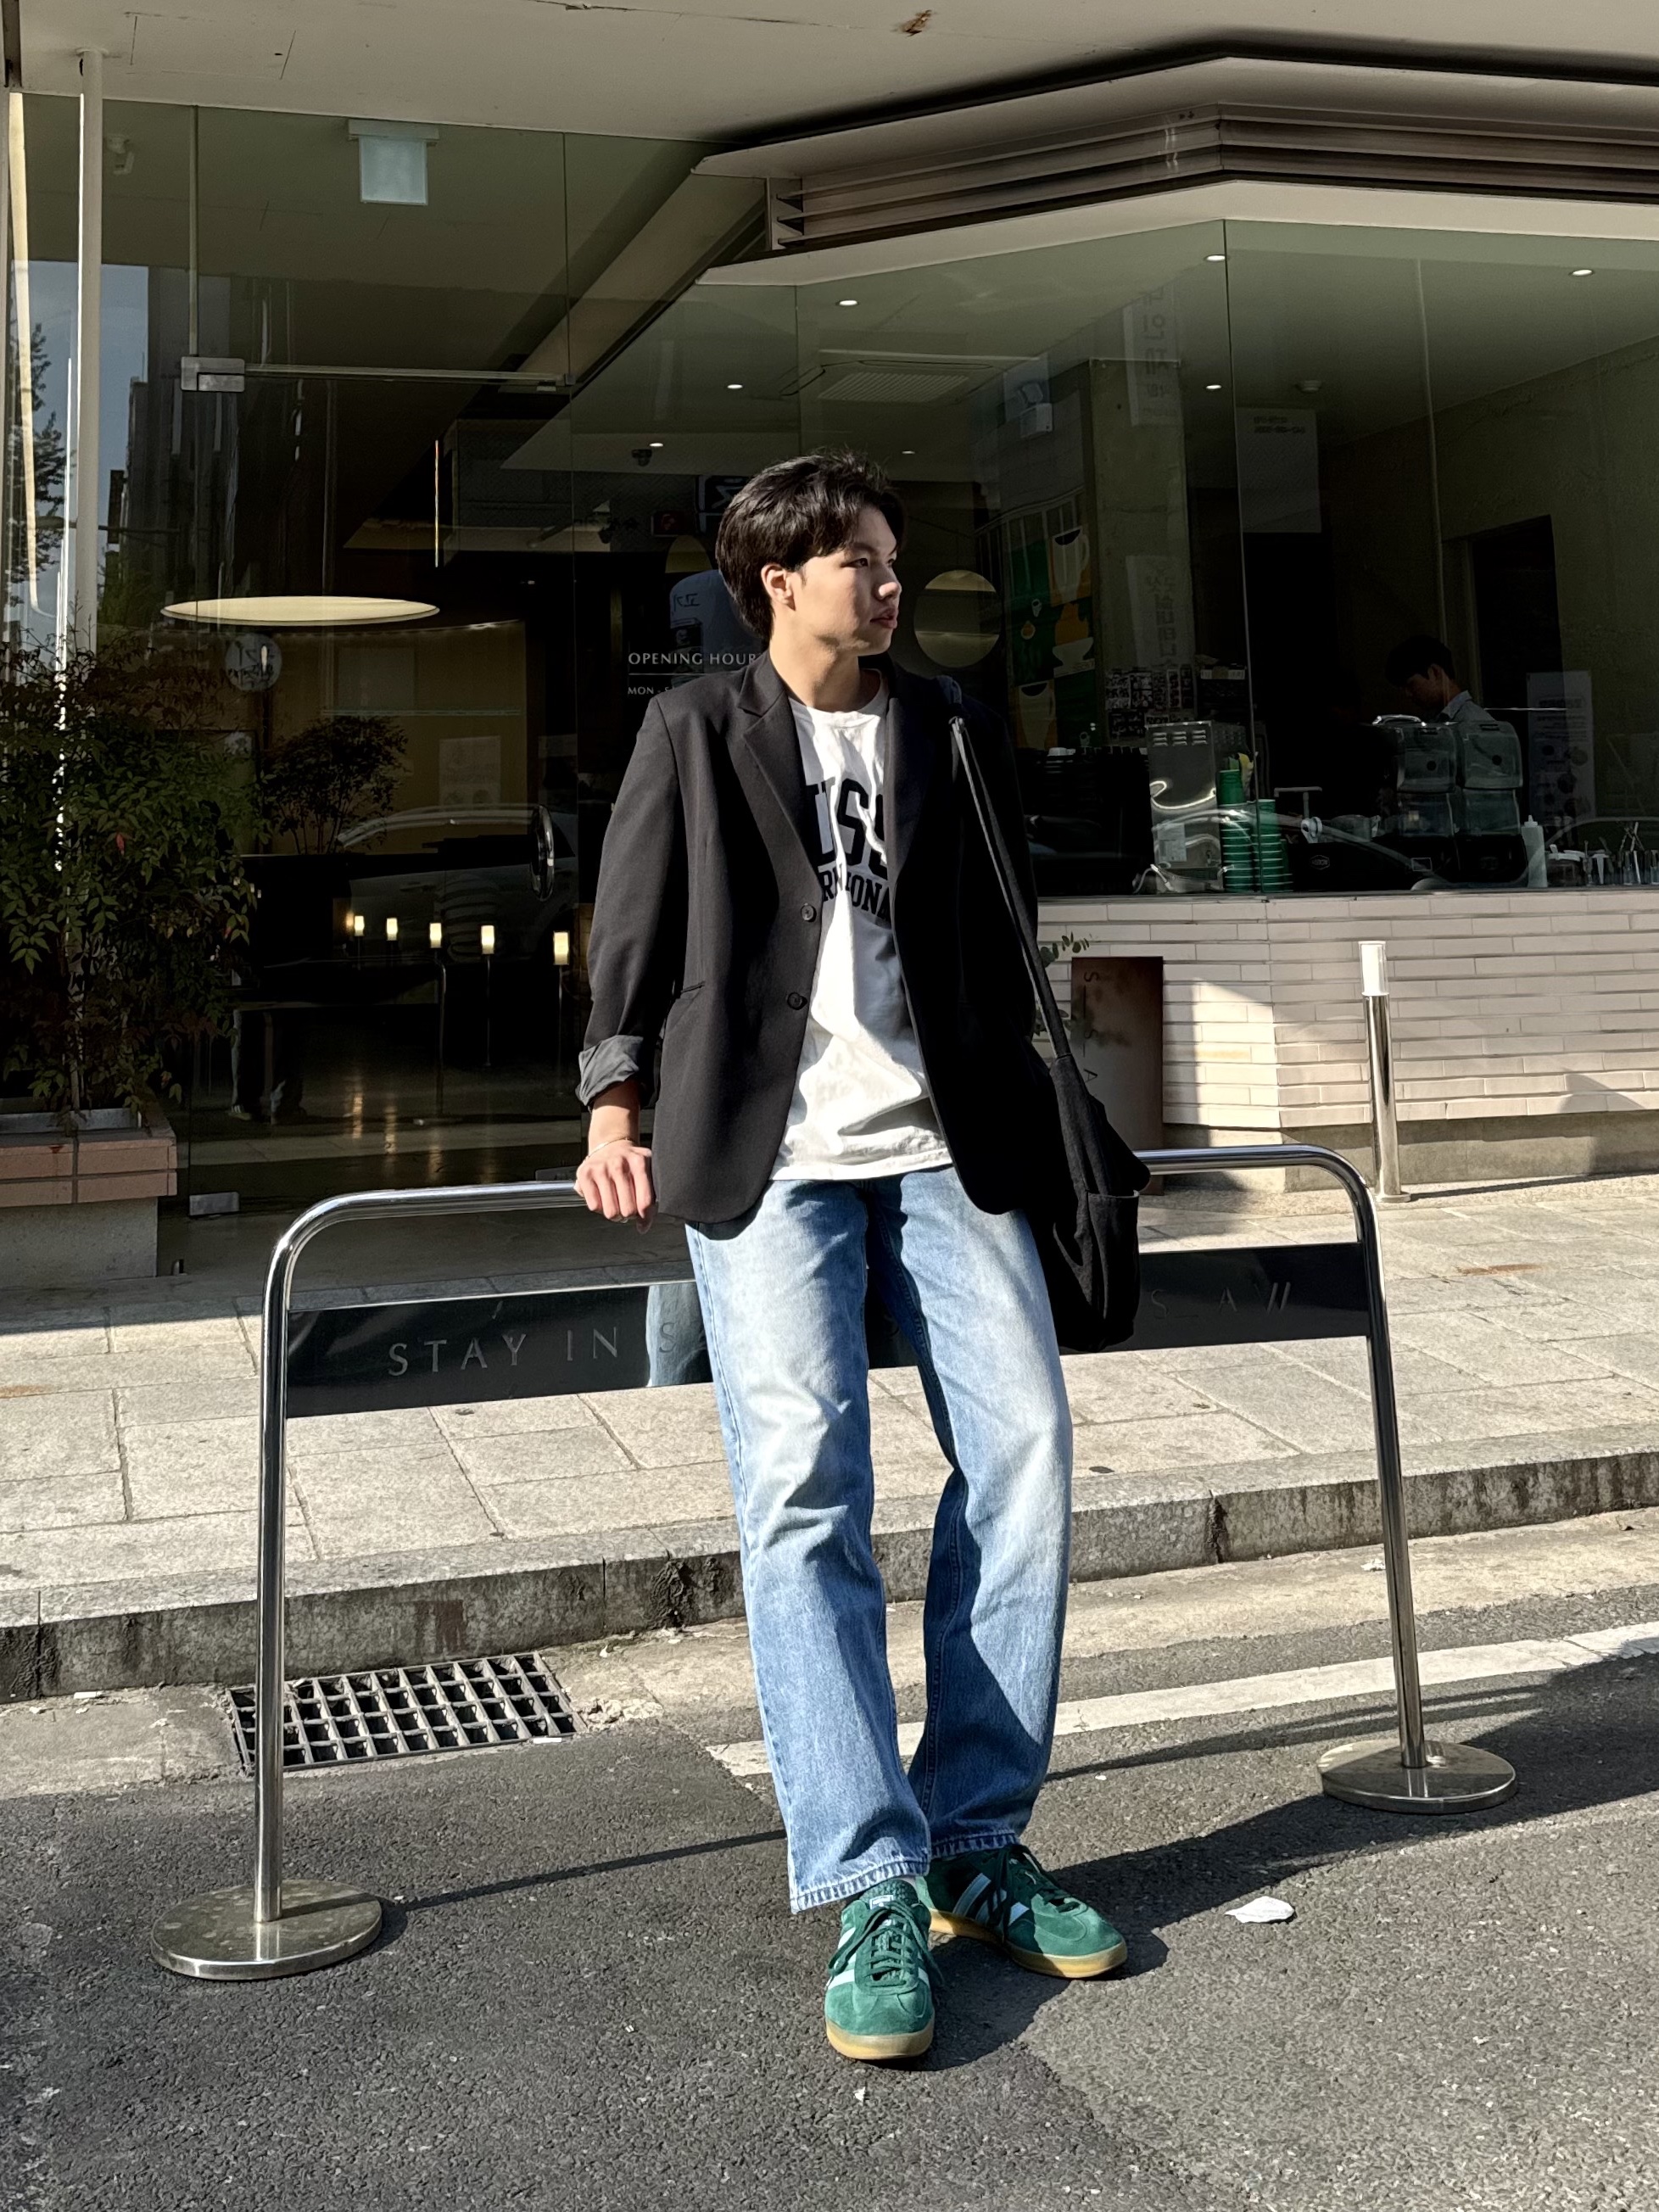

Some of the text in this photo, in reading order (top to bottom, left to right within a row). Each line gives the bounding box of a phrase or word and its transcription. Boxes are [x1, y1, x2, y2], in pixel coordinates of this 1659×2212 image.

[628, 652, 761, 665] OPENING HOUR
[628, 686, 654, 695] MON
[387, 1332, 527, 1377] STAY
[567, 1326, 618, 1362] IN
